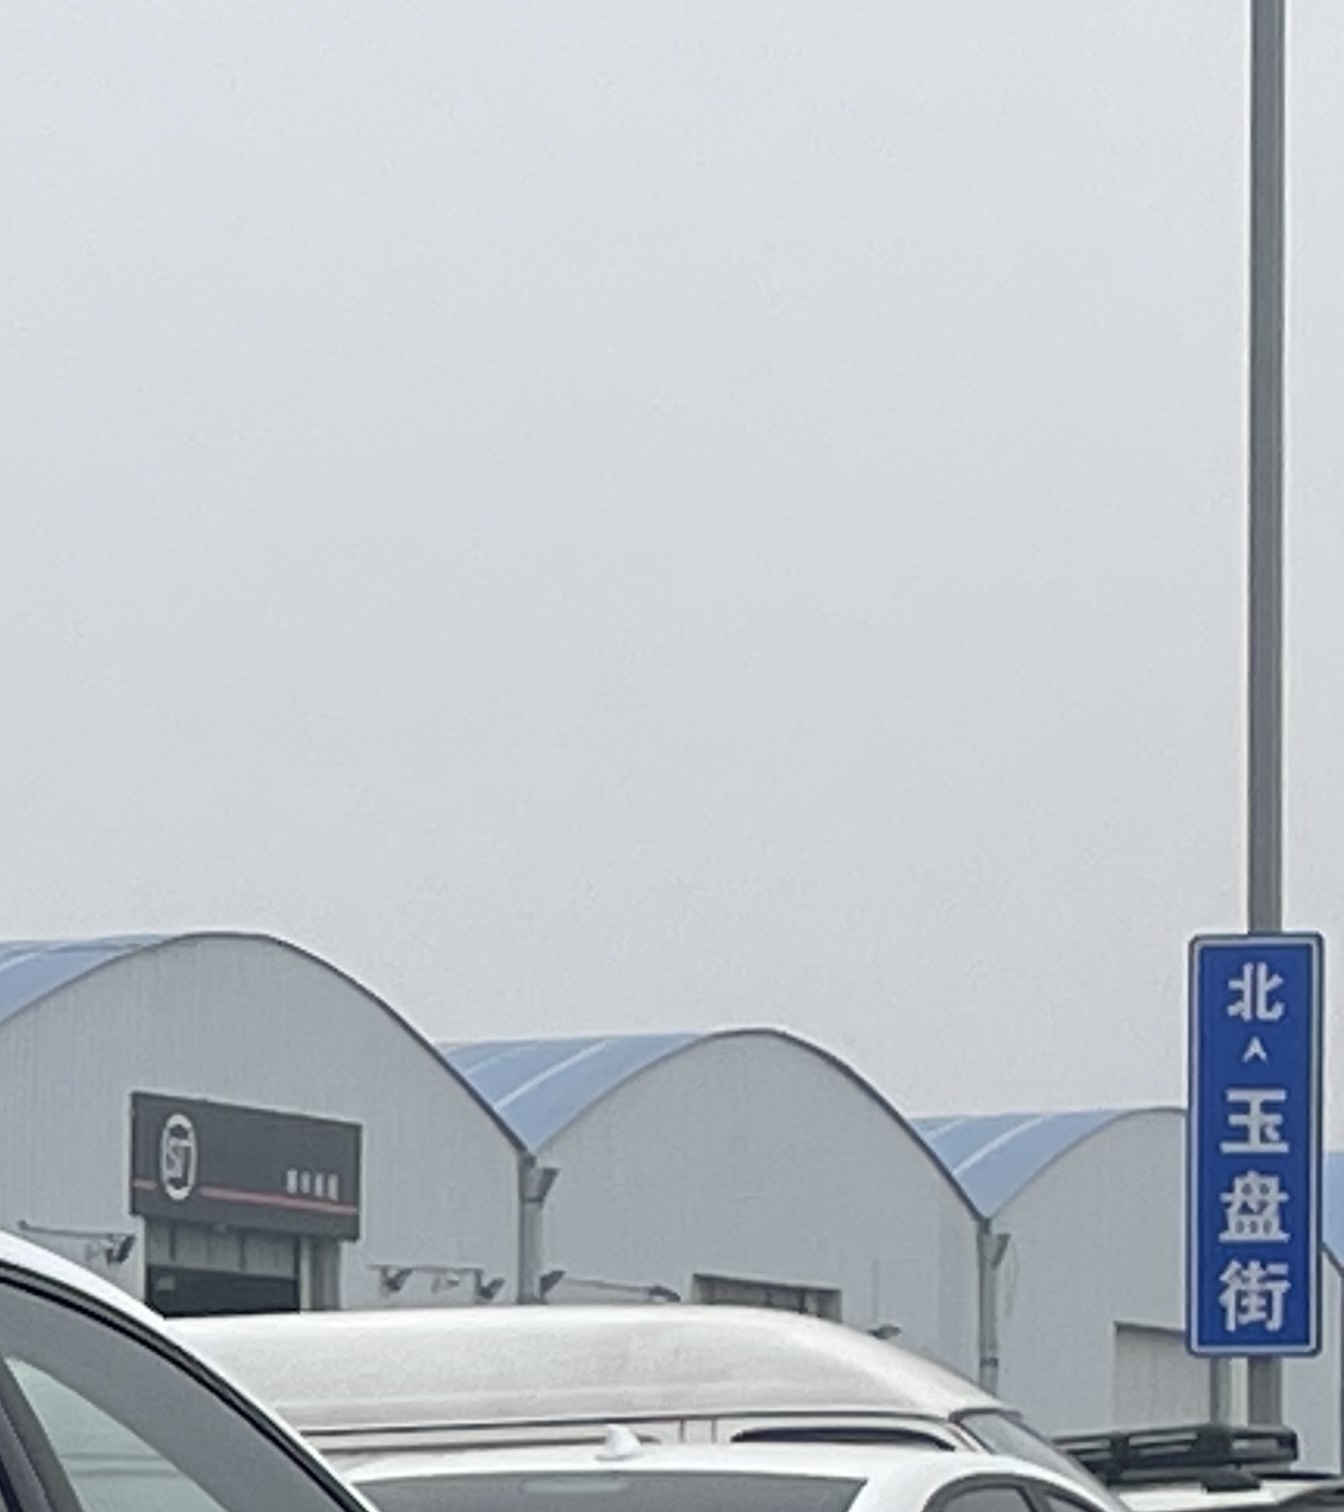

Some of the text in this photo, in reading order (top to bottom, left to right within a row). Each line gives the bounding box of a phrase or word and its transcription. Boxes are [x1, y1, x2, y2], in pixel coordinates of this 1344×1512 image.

[1226, 961, 1285, 1023] 北
[1218, 1088, 1291, 1333] 玉盘街
